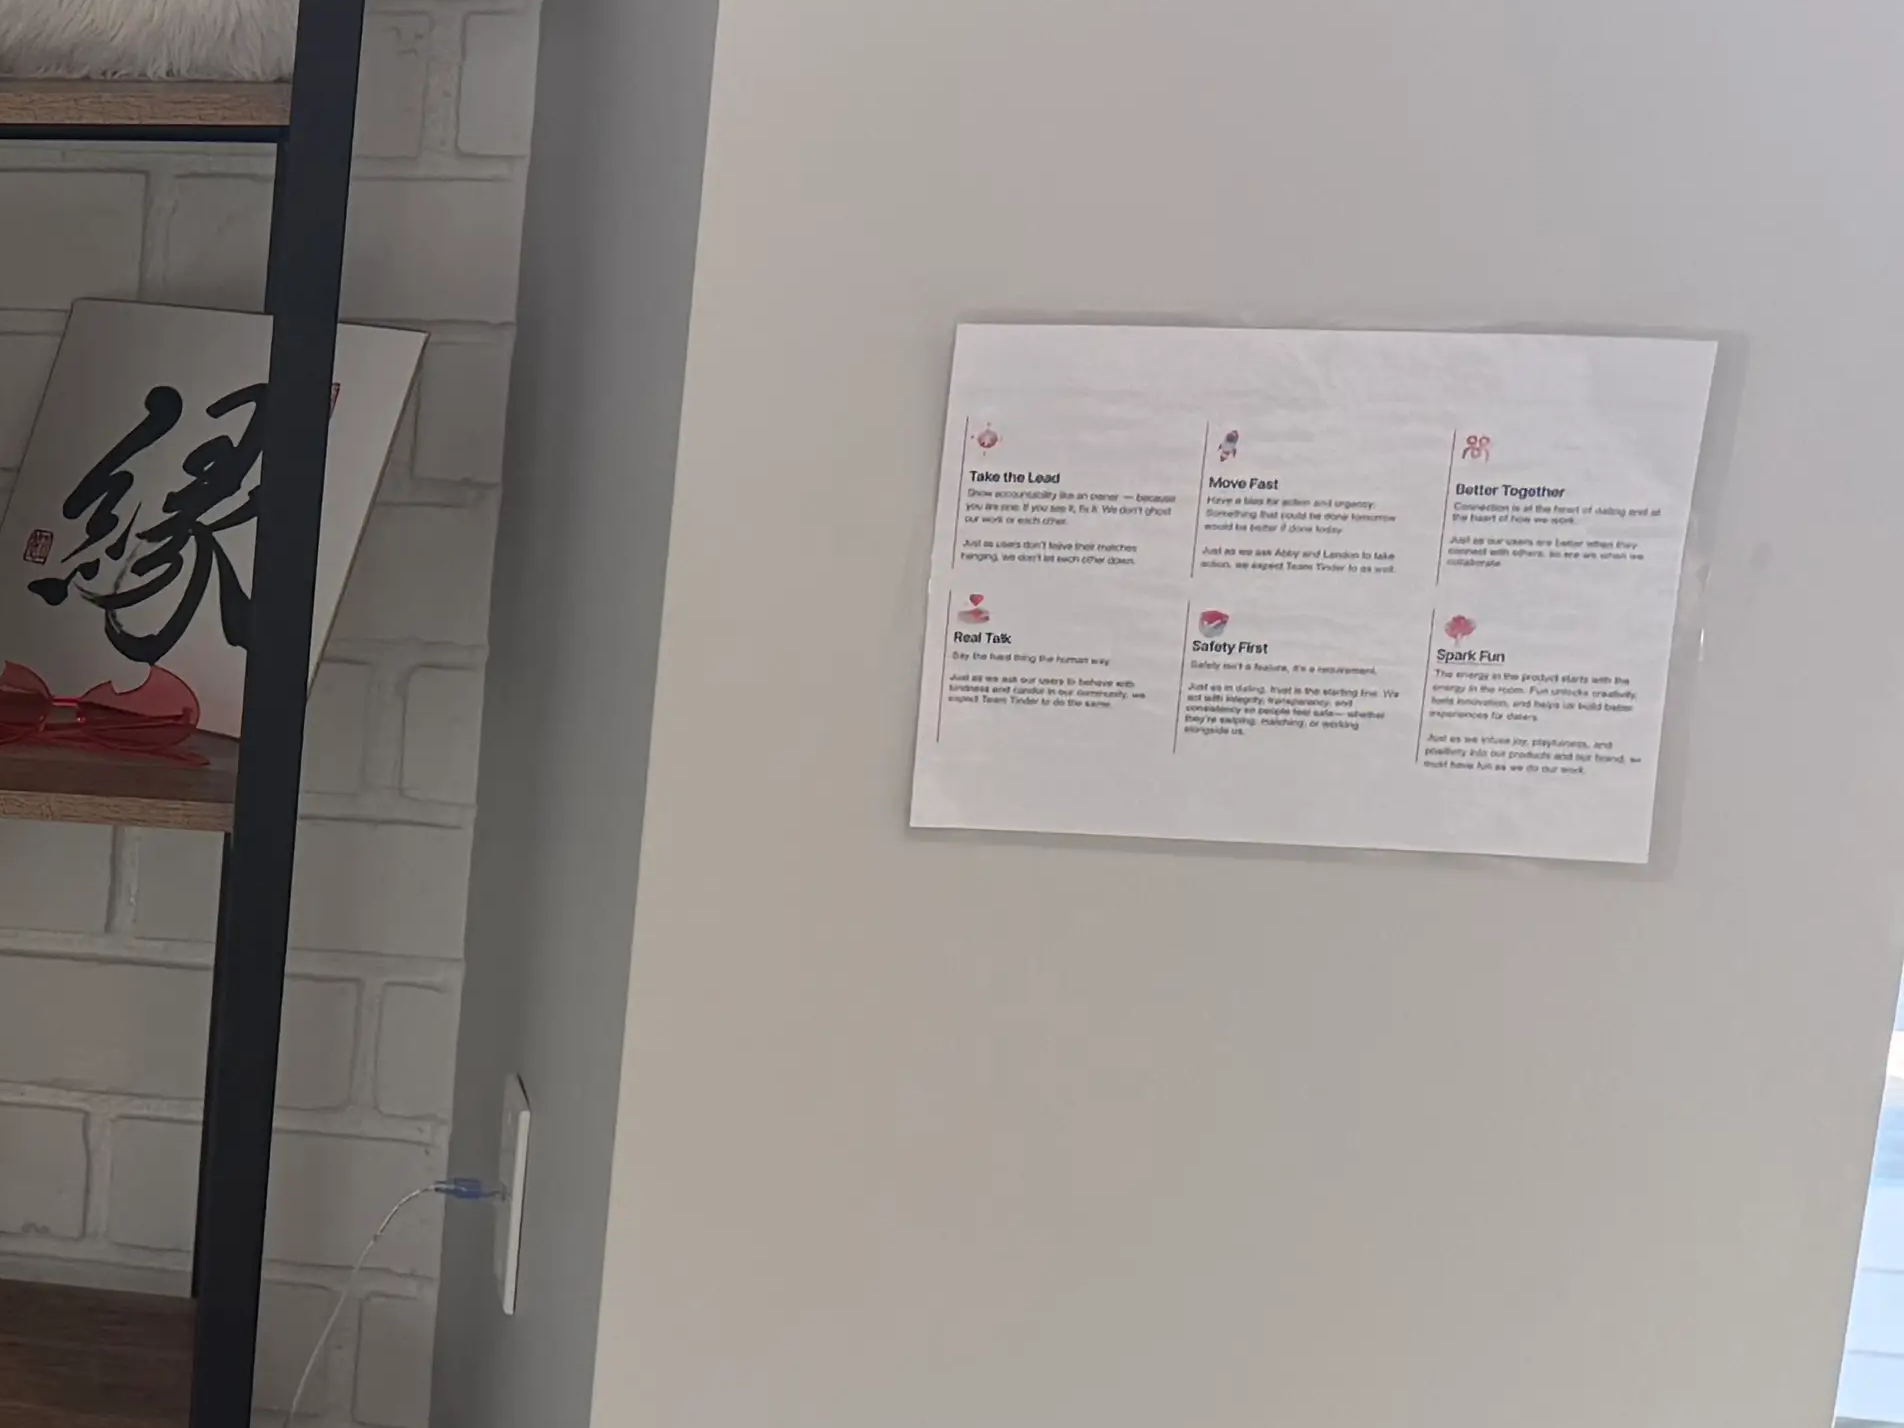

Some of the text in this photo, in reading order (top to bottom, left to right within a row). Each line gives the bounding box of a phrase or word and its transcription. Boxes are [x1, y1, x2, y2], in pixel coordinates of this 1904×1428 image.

[969, 471, 1061, 484] Take the Lead
[1208, 476, 1279, 490] Move Fast
[1455, 483, 1566, 500] Better Together
[953, 631, 1012, 645] Real Talk
[1191, 641, 1268, 655] Safety First
[1436, 649, 1505, 664] Spark Fun
